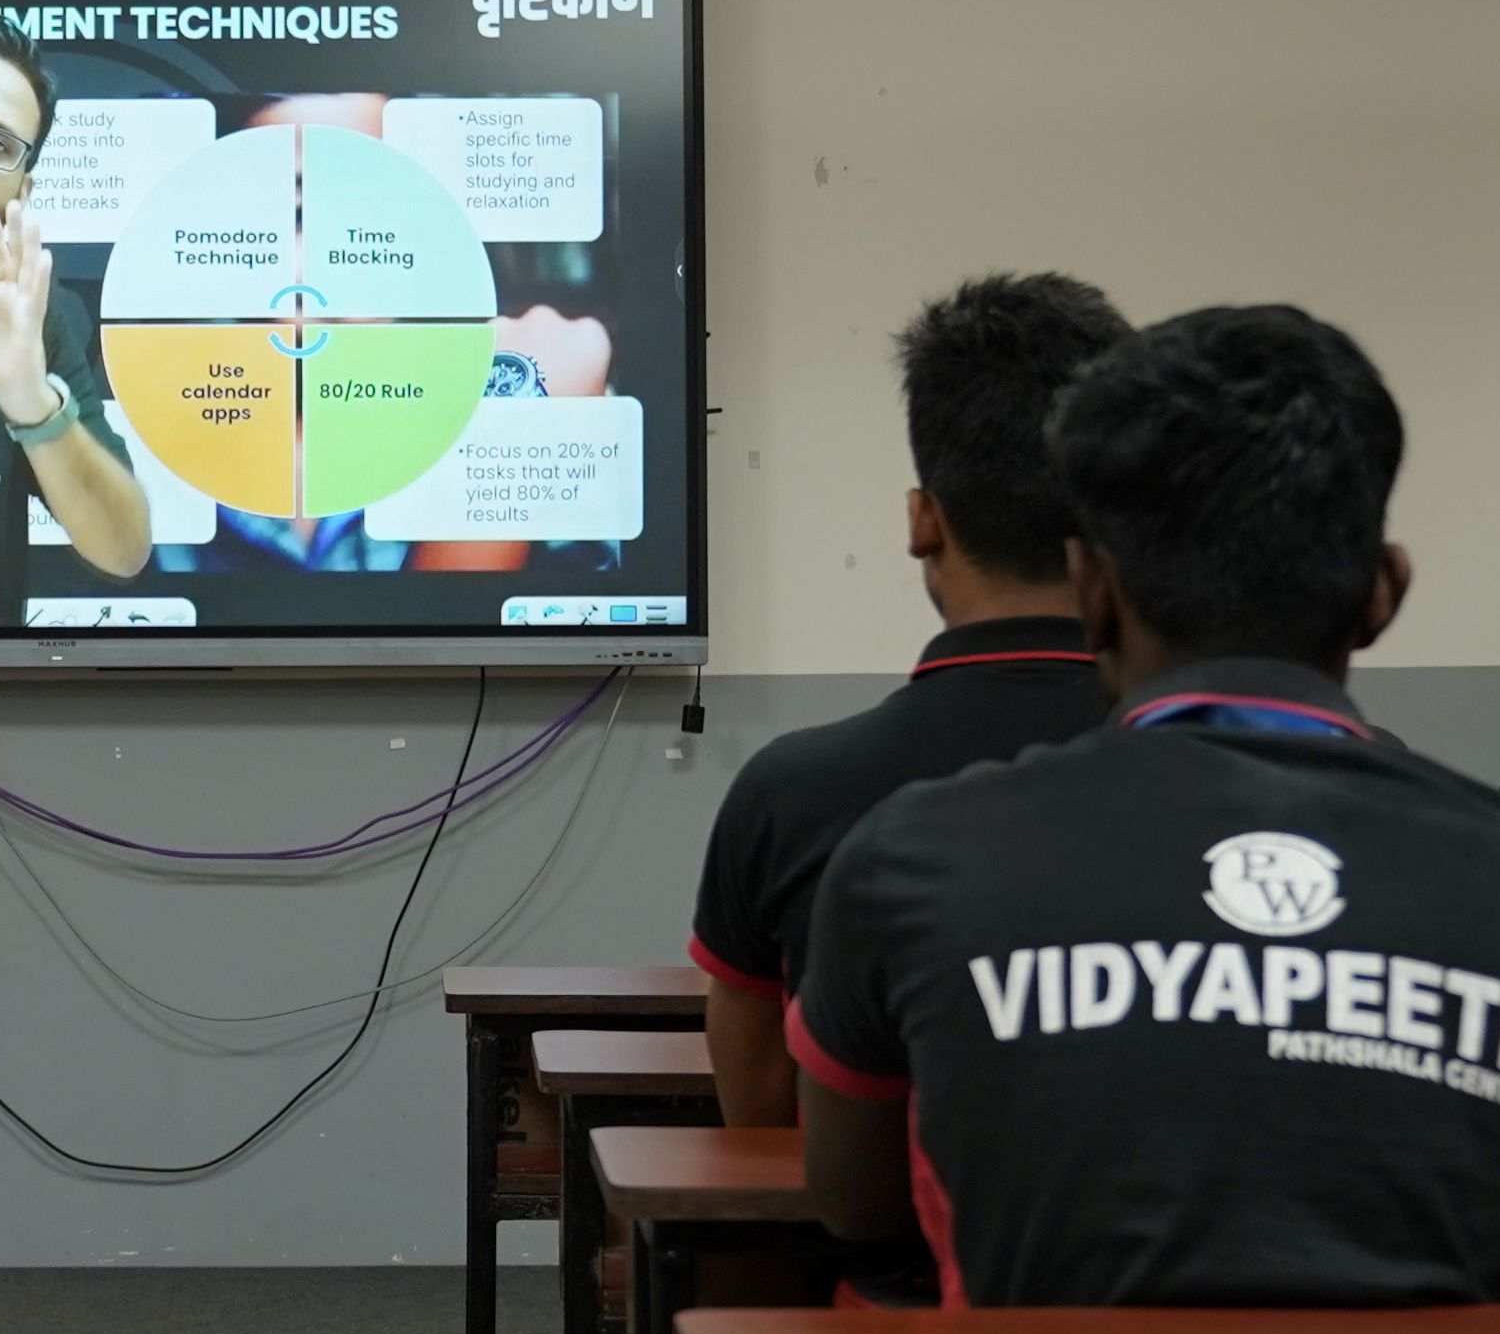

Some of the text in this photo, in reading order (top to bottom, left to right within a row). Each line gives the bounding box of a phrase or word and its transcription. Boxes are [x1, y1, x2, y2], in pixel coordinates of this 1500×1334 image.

[130, 6, 399, 44] TECHNIQUES
[69, 112, 115, 129] study
[466, 111, 523, 129] Assign
[43, 133, 125, 147] sions into
[466, 131, 572, 149] specific time
[466, 152, 534, 168] slots for
[34, 175, 124, 190] ervals with
[466, 174, 575, 191] studying and
[62, 195, 119, 209] breaks
[466, 194, 549, 208] relaxation
[175, 229, 278, 244] Pomodoro
[347, 229, 396, 244] Time
[174, 250, 279, 270] Technique
[328, 250, 414, 269] Blocking
[208, 364, 244, 378] Use
[181, 384, 272, 399] calendar
[319, 380, 424, 402] 80/20 Rule
[201, 407, 251, 424] apps
[466, 443, 619, 459] Focus on 20% of
[466, 465, 596, 480] tasks that will
[466, 485, 579, 505] yield 80% of
[466, 507, 529, 522] results
[1268, 1029, 1443, 1085] PATHSHALA
